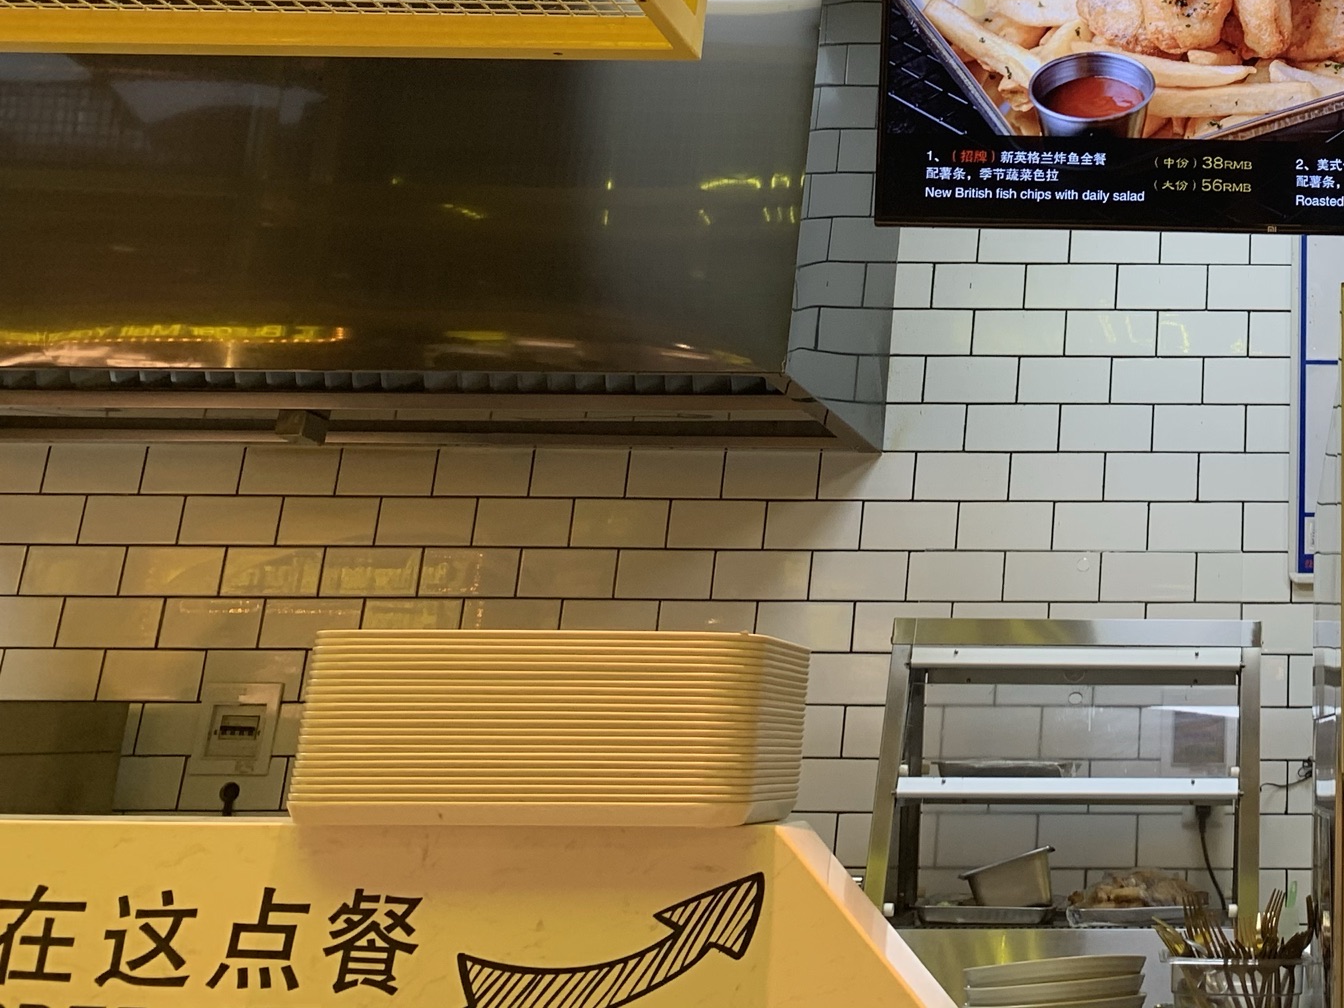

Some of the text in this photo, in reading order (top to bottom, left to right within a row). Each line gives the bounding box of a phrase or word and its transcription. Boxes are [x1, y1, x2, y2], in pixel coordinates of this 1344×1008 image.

[925, 187, 1145, 204] New British fish chips with daily salad
[1295, 195, 1344, 207] Roasted
[0, 885, 423, 995] 在这点餐
